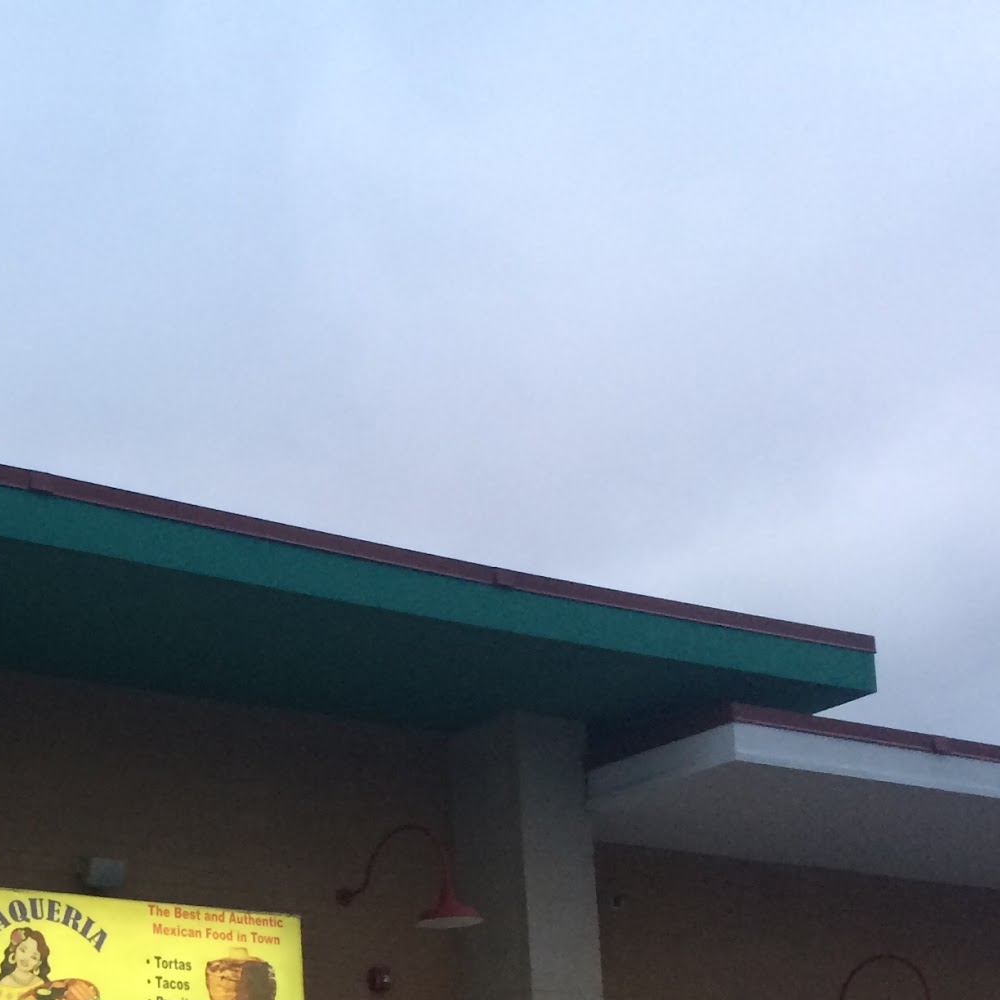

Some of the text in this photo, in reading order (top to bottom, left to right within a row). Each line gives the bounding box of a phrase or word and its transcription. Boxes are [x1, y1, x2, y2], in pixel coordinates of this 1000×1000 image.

[148, 904, 284, 929] The Best and Authentic
[152, 923, 281, 946] Mexican Food in Town
[154, 955, 193, 972] Tortas
[155, 976, 191, 991] Tacos
